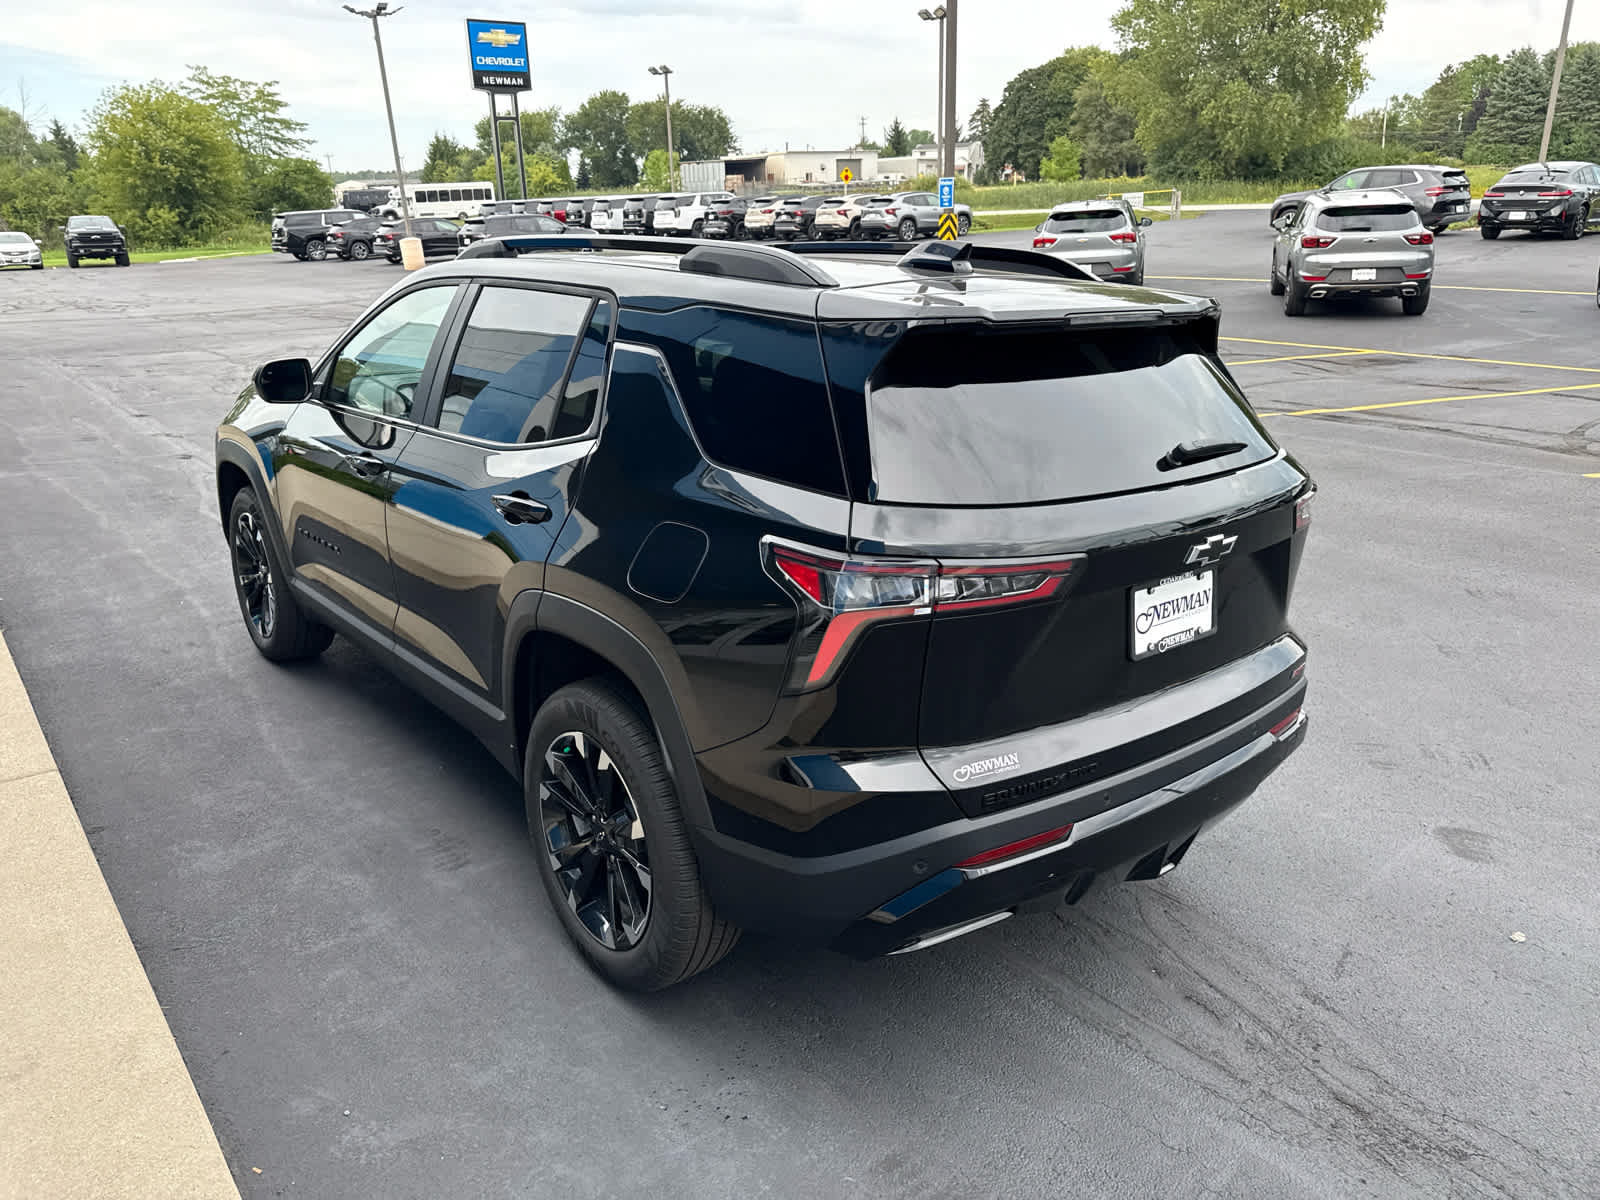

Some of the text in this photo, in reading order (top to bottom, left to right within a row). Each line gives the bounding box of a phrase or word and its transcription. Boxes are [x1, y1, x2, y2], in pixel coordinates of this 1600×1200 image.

[476, 56, 525, 67] CHEVROLET
[482, 76, 524, 86] NEWMAN
[1136, 588, 1211, 634] NEWMAN
[953, 752, 1019, 782] NEWMAN
